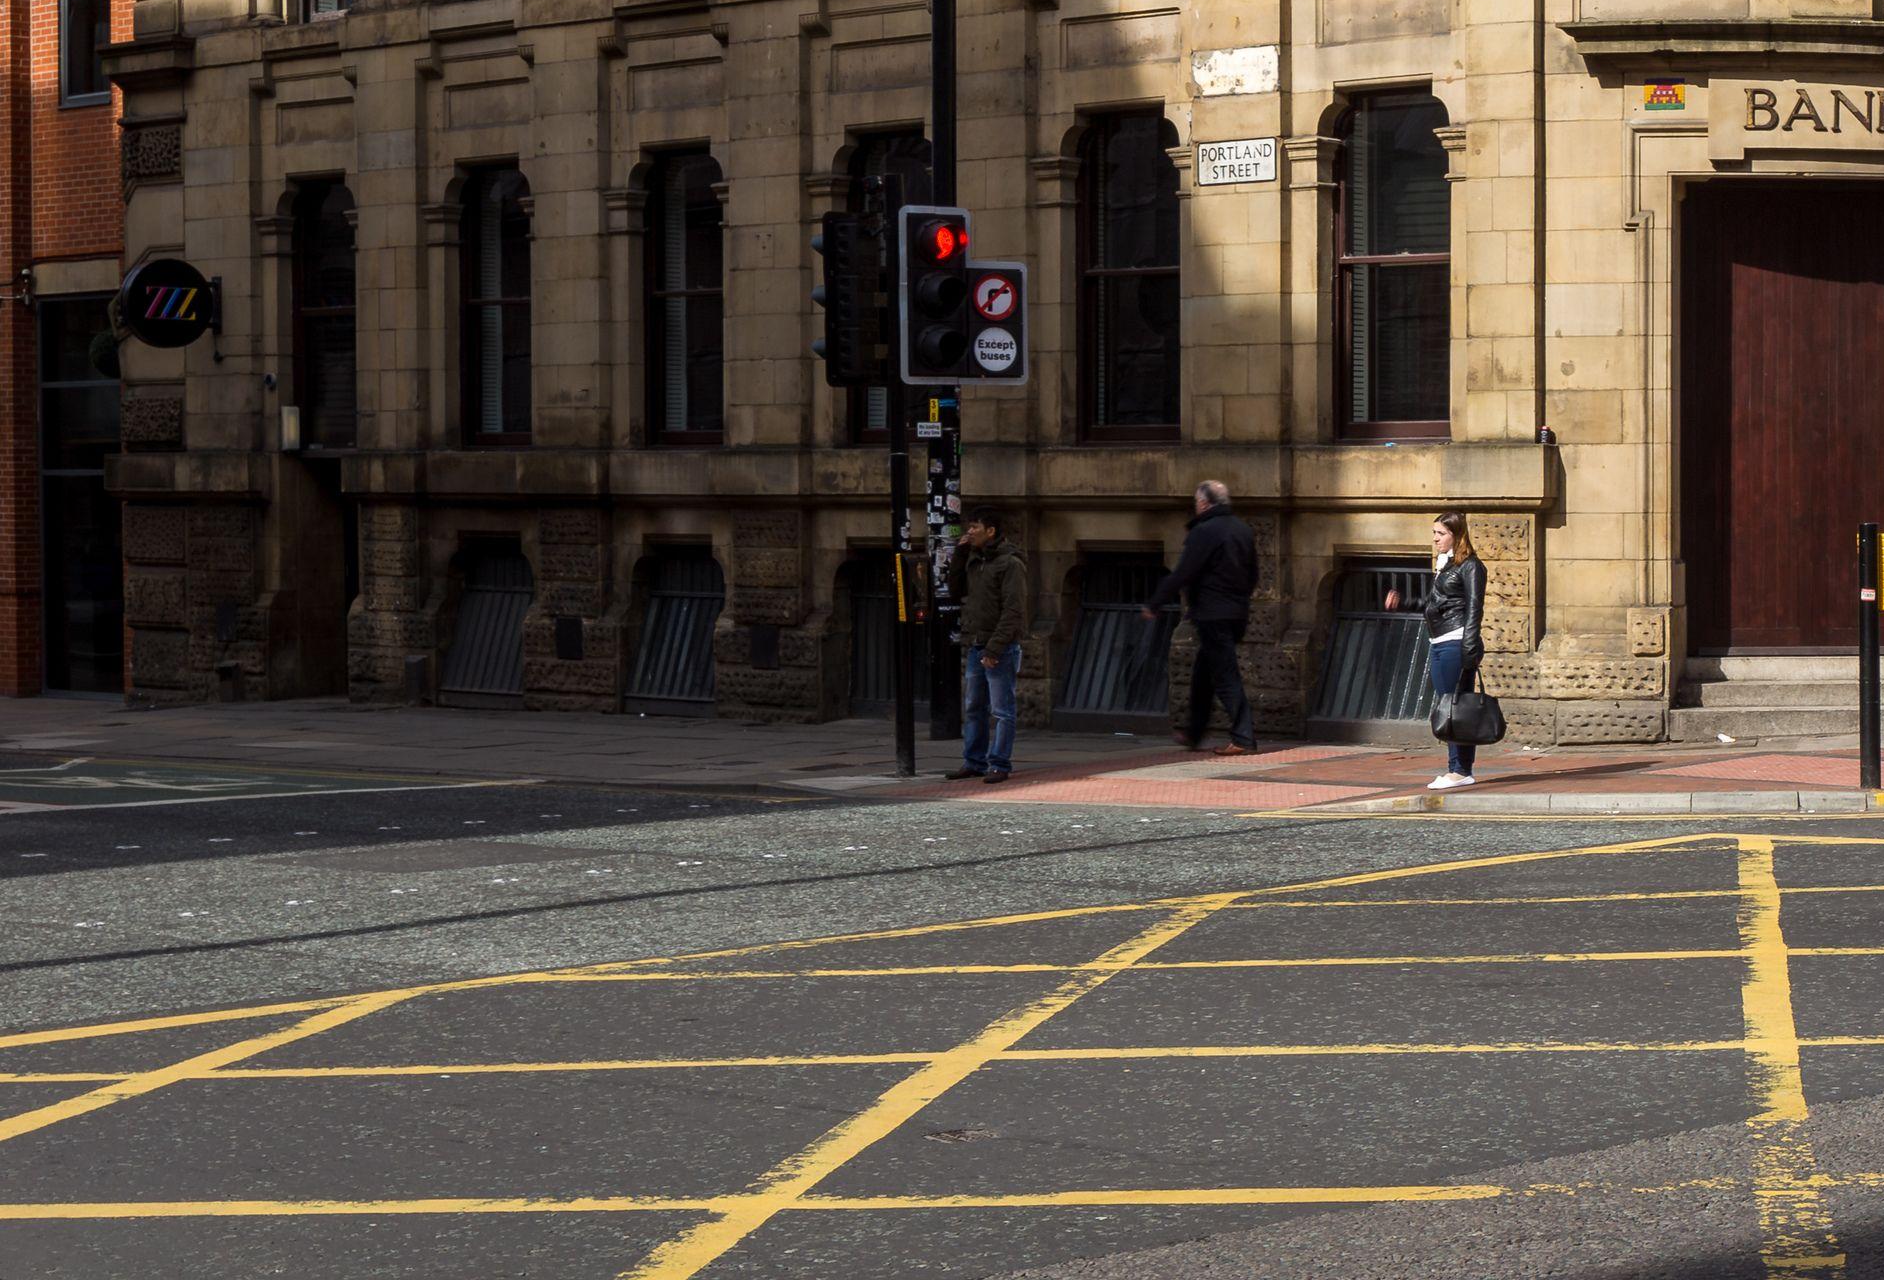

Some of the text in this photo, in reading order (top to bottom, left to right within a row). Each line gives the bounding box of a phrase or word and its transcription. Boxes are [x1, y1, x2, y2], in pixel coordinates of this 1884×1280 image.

[1201, 143, 1272, 162] PORTLAND
[1213, 163, 1260, 180] STREET
[978, 339, 1015, 351] Except
[980, 351, 1011, 361] buses
